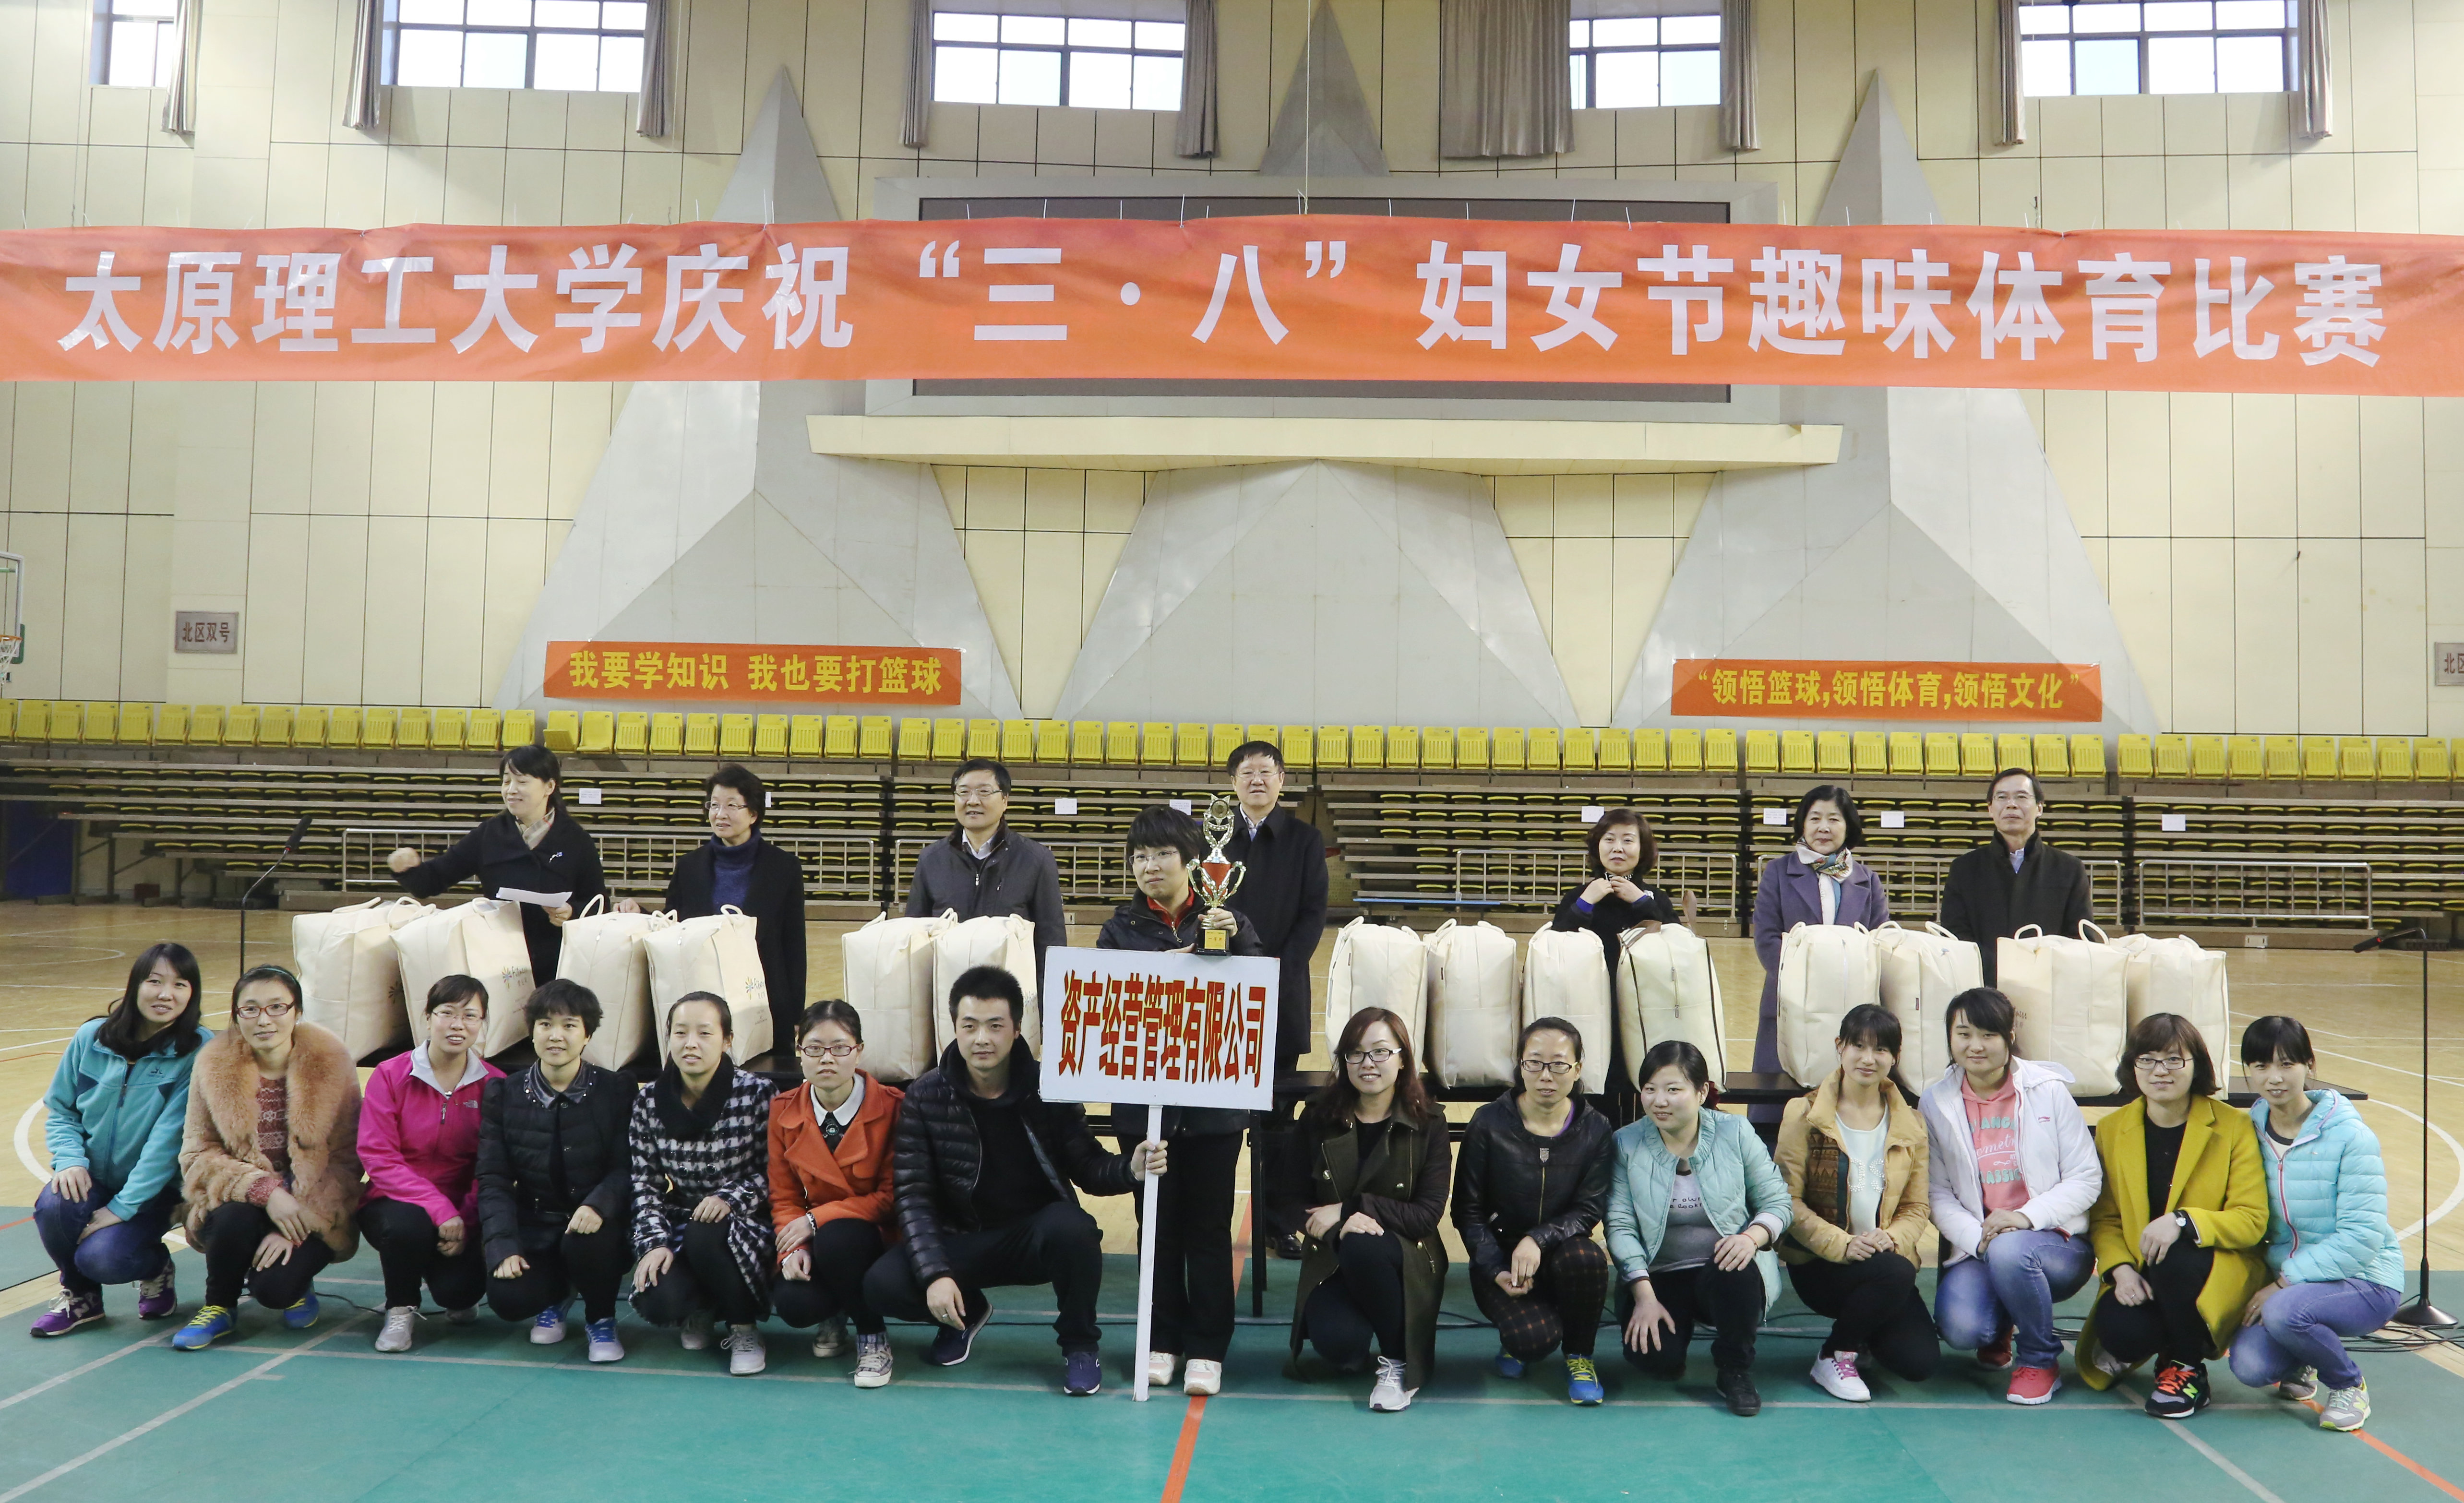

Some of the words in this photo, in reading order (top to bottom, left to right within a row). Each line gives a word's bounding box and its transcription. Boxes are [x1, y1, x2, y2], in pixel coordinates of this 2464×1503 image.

[57, 241, 853, 355] 太原理工大学庆祝
[1416, 240, 2387, 368] 妇女节趣味体育比赛
[182, 621, 230, 643] 北区双号
[569, 650, 727, 691] 我要学知识
[748, 653, 943, 695] 我也要打篮球
[1058, 969, 1266, 1088] 资产经营管理有限公司
